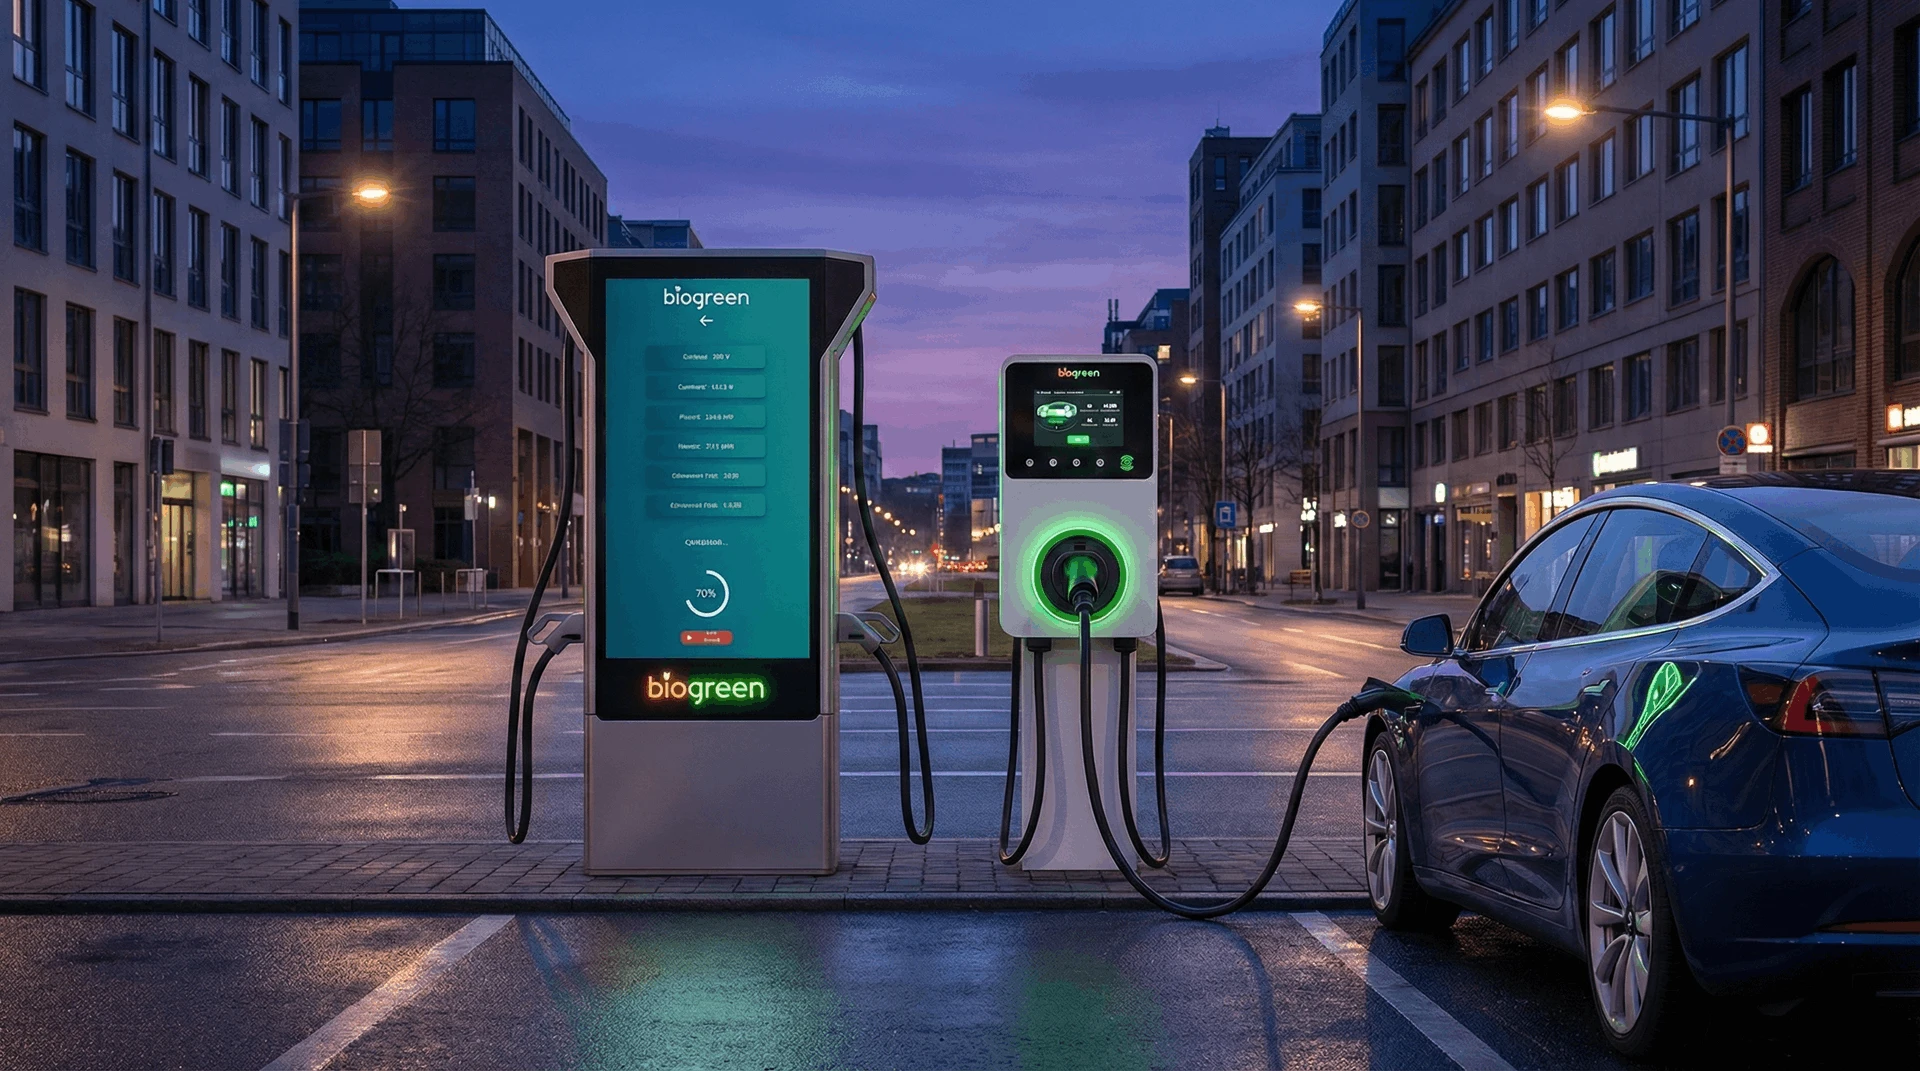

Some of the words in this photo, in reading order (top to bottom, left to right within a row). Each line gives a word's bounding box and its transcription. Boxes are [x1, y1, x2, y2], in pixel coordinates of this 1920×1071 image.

[664, 286, 749, 310] biogreen
[1057, 367, 1100, 379] biogreen
[695, 588, 717, 599] 70%
[648, 671, 764, 705] biogreen
